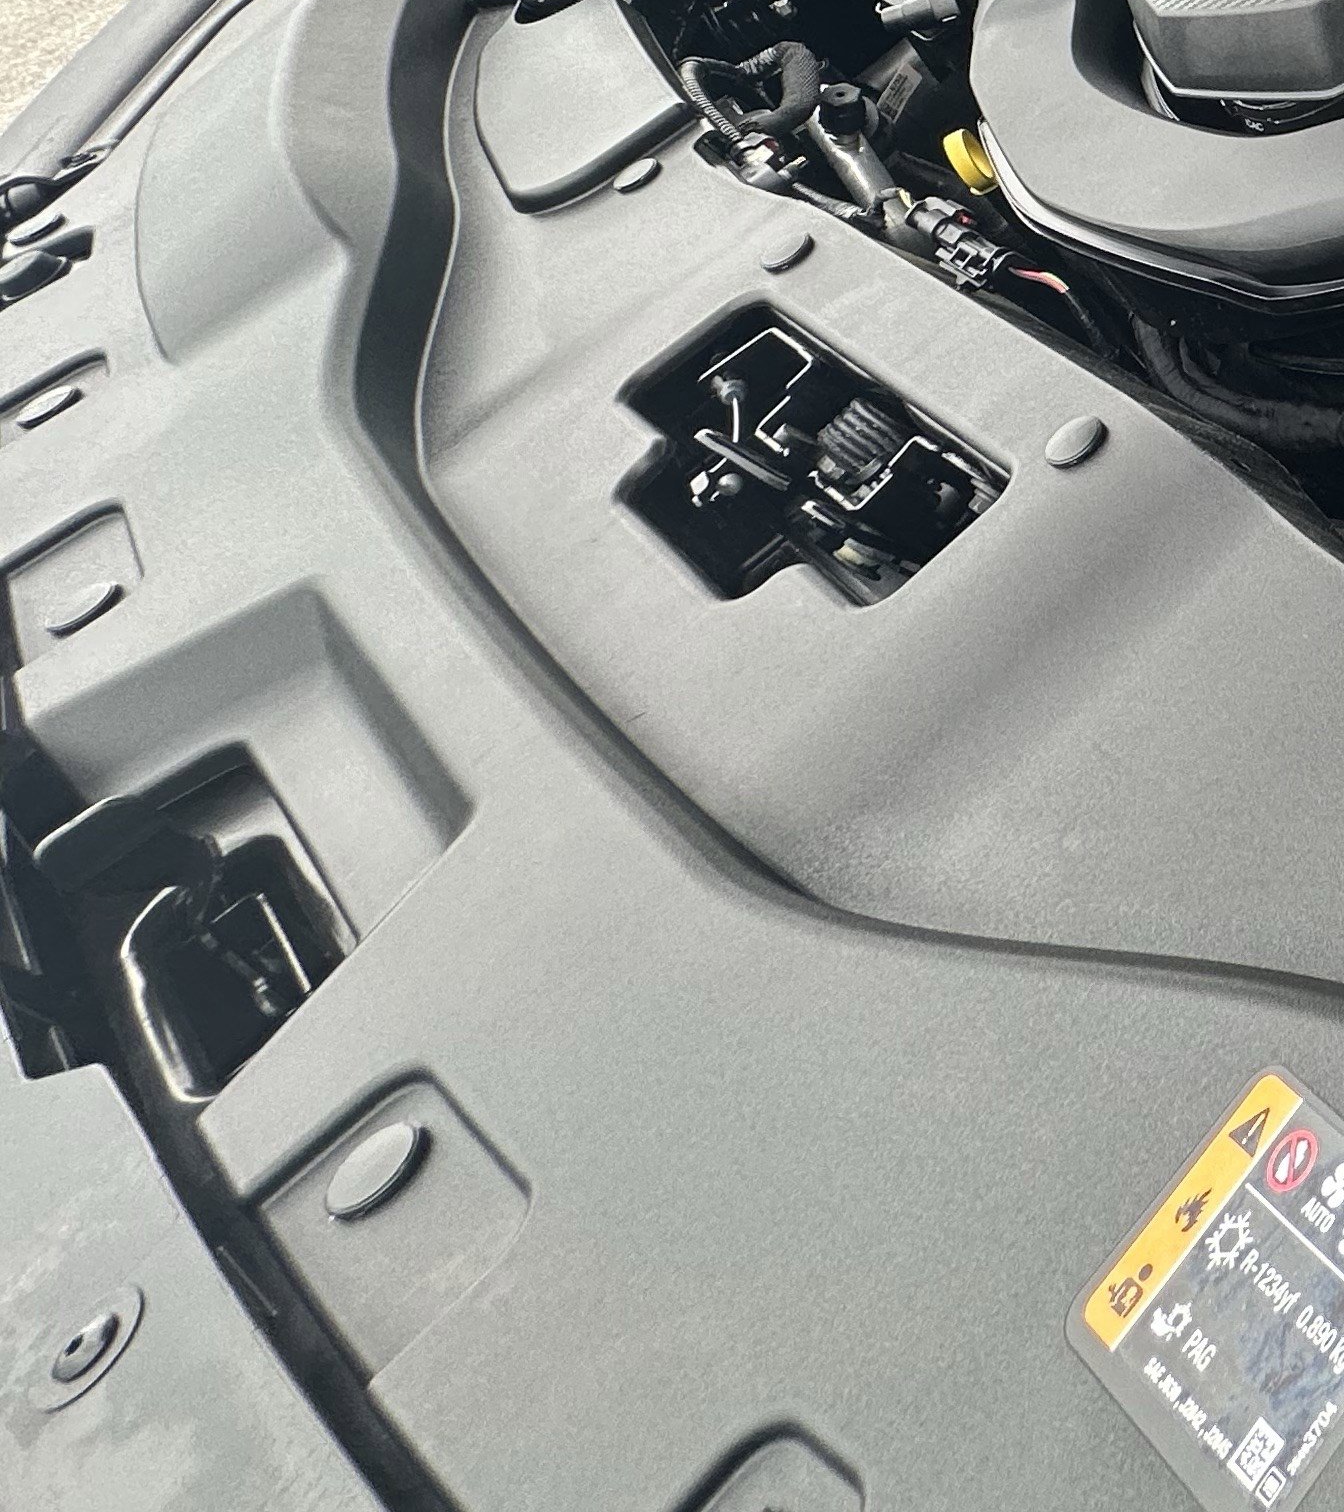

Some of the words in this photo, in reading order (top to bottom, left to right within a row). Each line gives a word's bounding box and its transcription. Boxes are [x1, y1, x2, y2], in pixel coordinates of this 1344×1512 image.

[1299, 1196, 1336, 1233] AUTO
[1239, 1248, 1301, 1313] R-1234yf
[1295, 1304, 1338, 1353] 0.890
[1181, 1328, 1217, 1372] PAG
